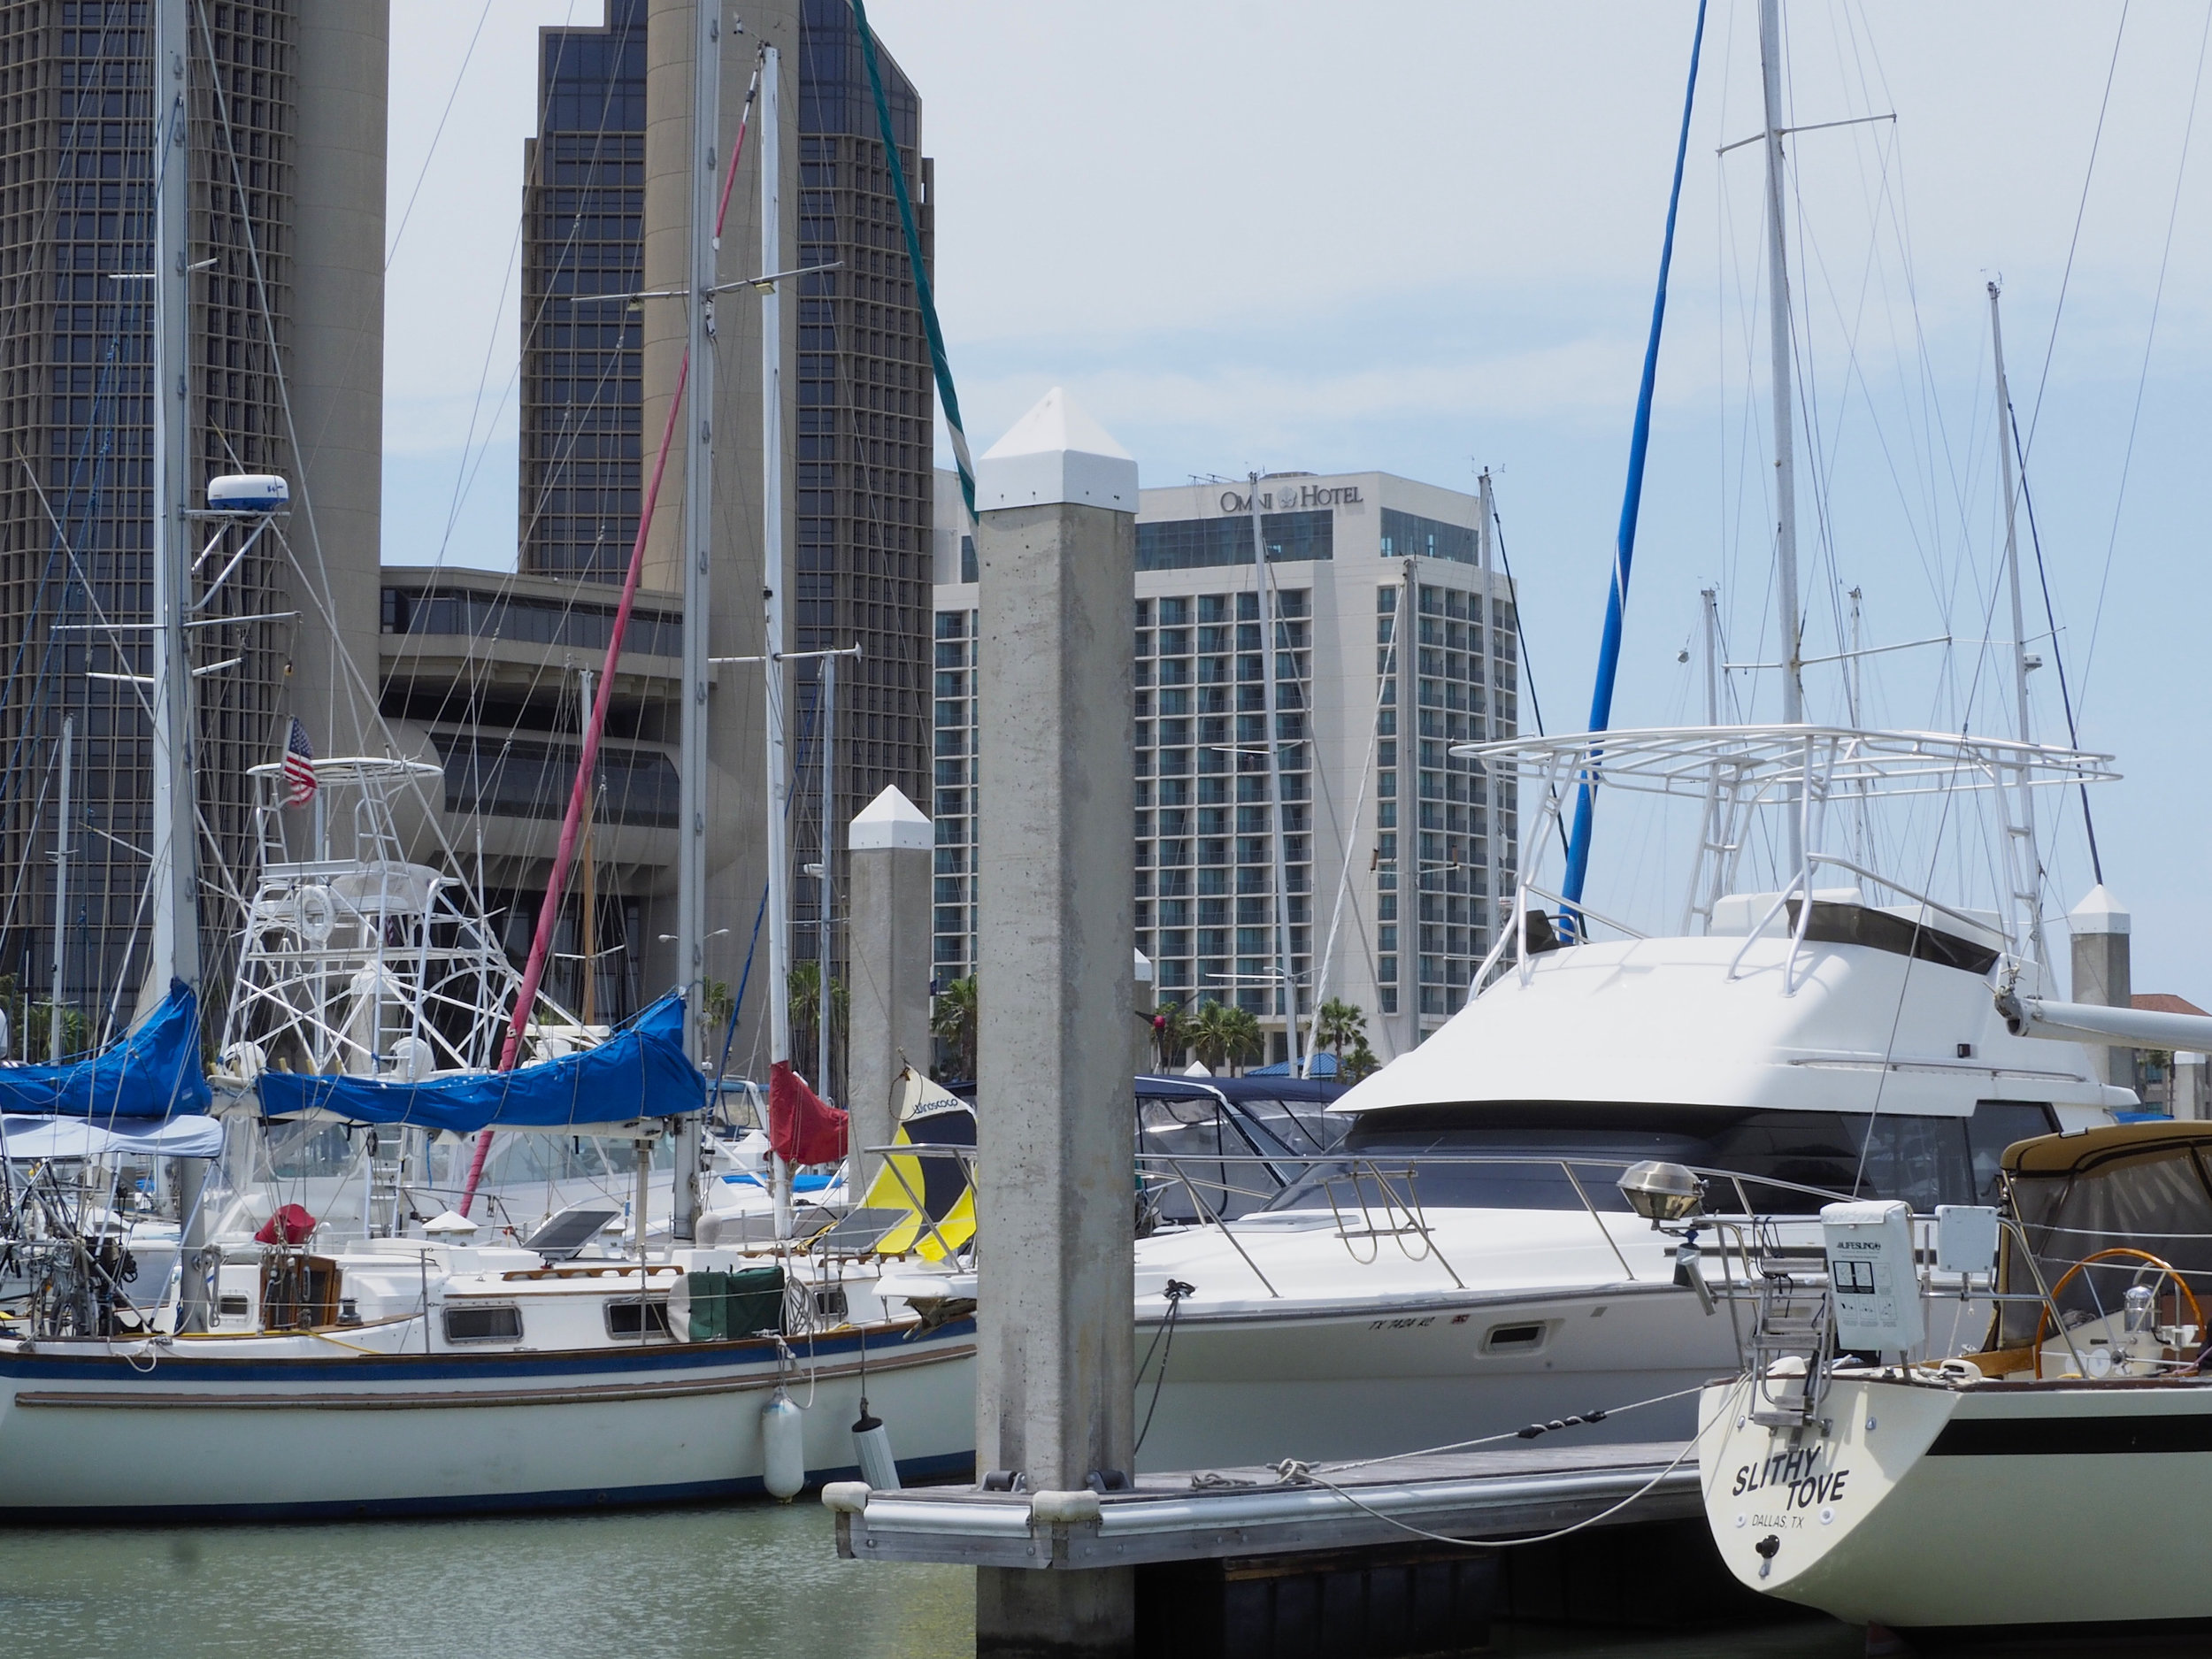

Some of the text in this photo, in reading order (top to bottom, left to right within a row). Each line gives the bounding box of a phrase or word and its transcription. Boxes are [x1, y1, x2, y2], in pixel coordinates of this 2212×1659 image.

[1220, 484, 1363, 513] OMNI HOTEL
[1732, 1445, 1821, 1496] SLITHY
[1786, 1470, 1849, 1510] TOVE
[1752, 1514, 1805, 1529] DALLAS, TX
